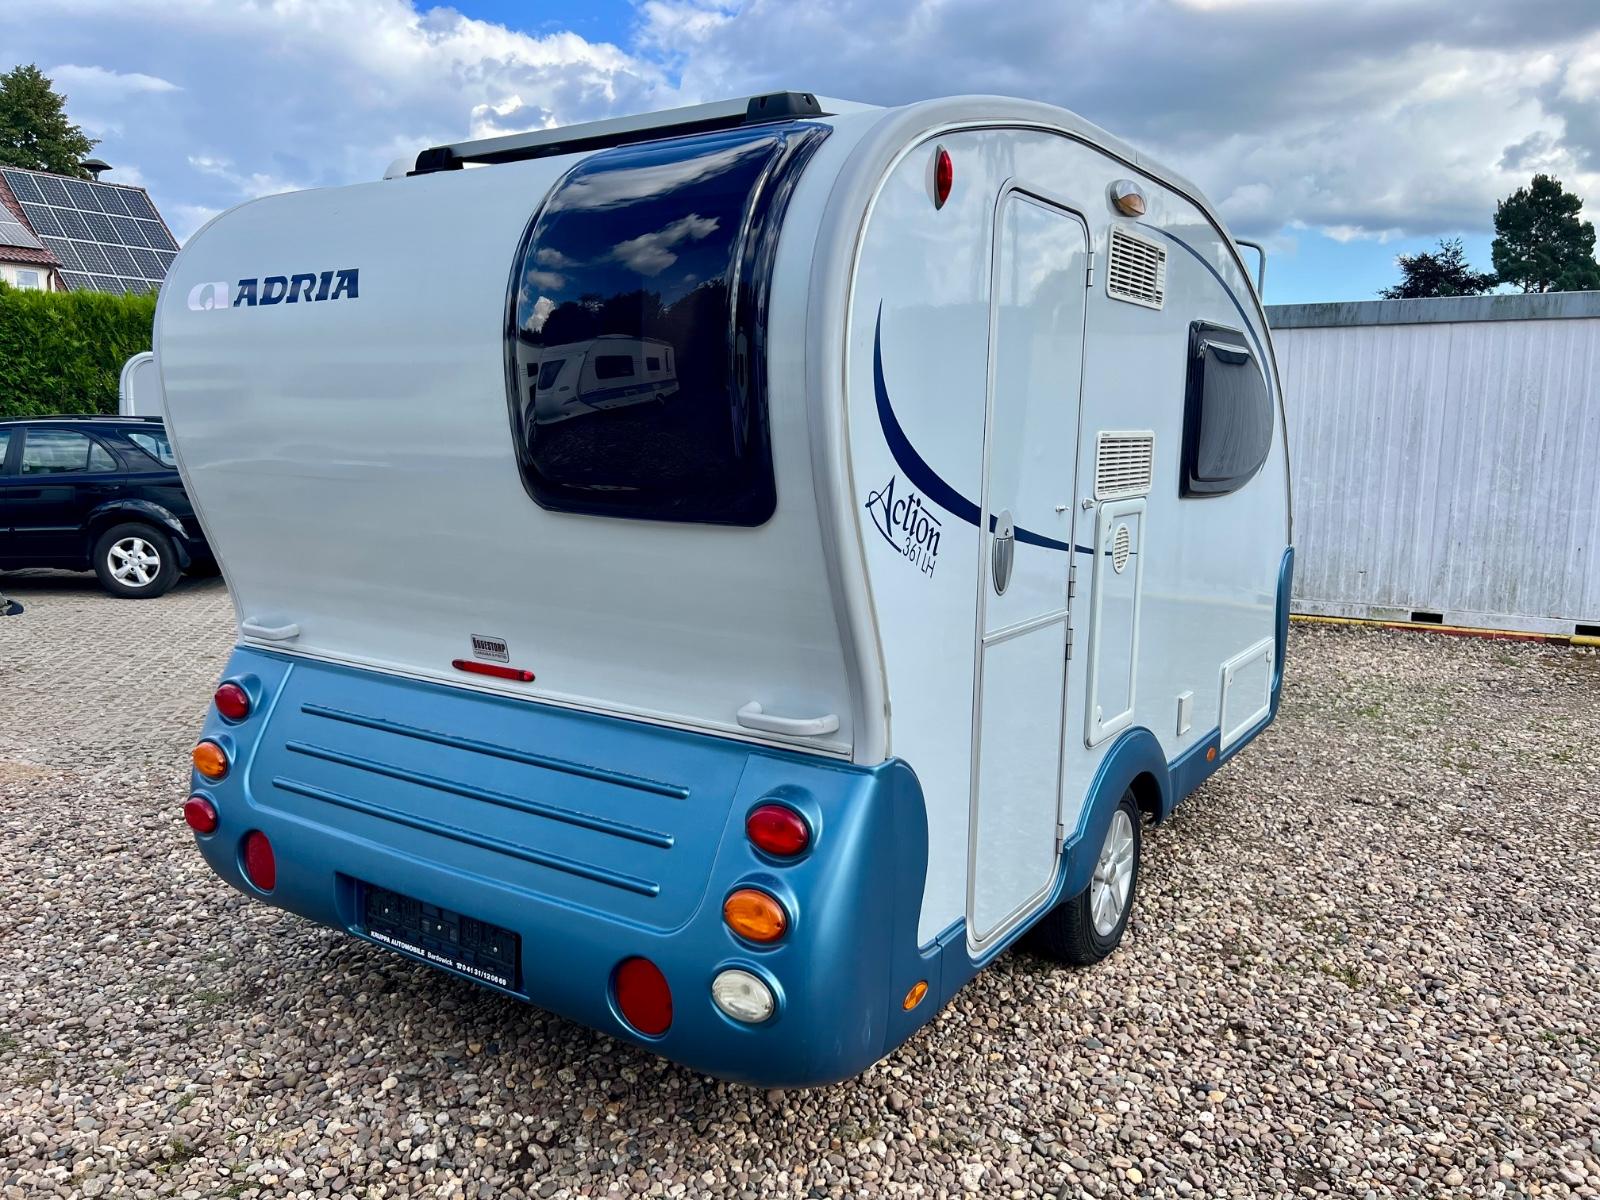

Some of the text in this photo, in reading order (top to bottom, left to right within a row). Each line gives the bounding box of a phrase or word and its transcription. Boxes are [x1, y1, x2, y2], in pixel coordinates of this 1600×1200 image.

[233, 268, 359, 307] ADRIA
[865, 474, 942, 557] Action
[902, 536, 936, 579] 361 LH
[370, 930, 391, 944] KRUPPA
[390, 938, 426, 956] AUTOMOBILE
[427, 951, 453, 967] Bardowick
